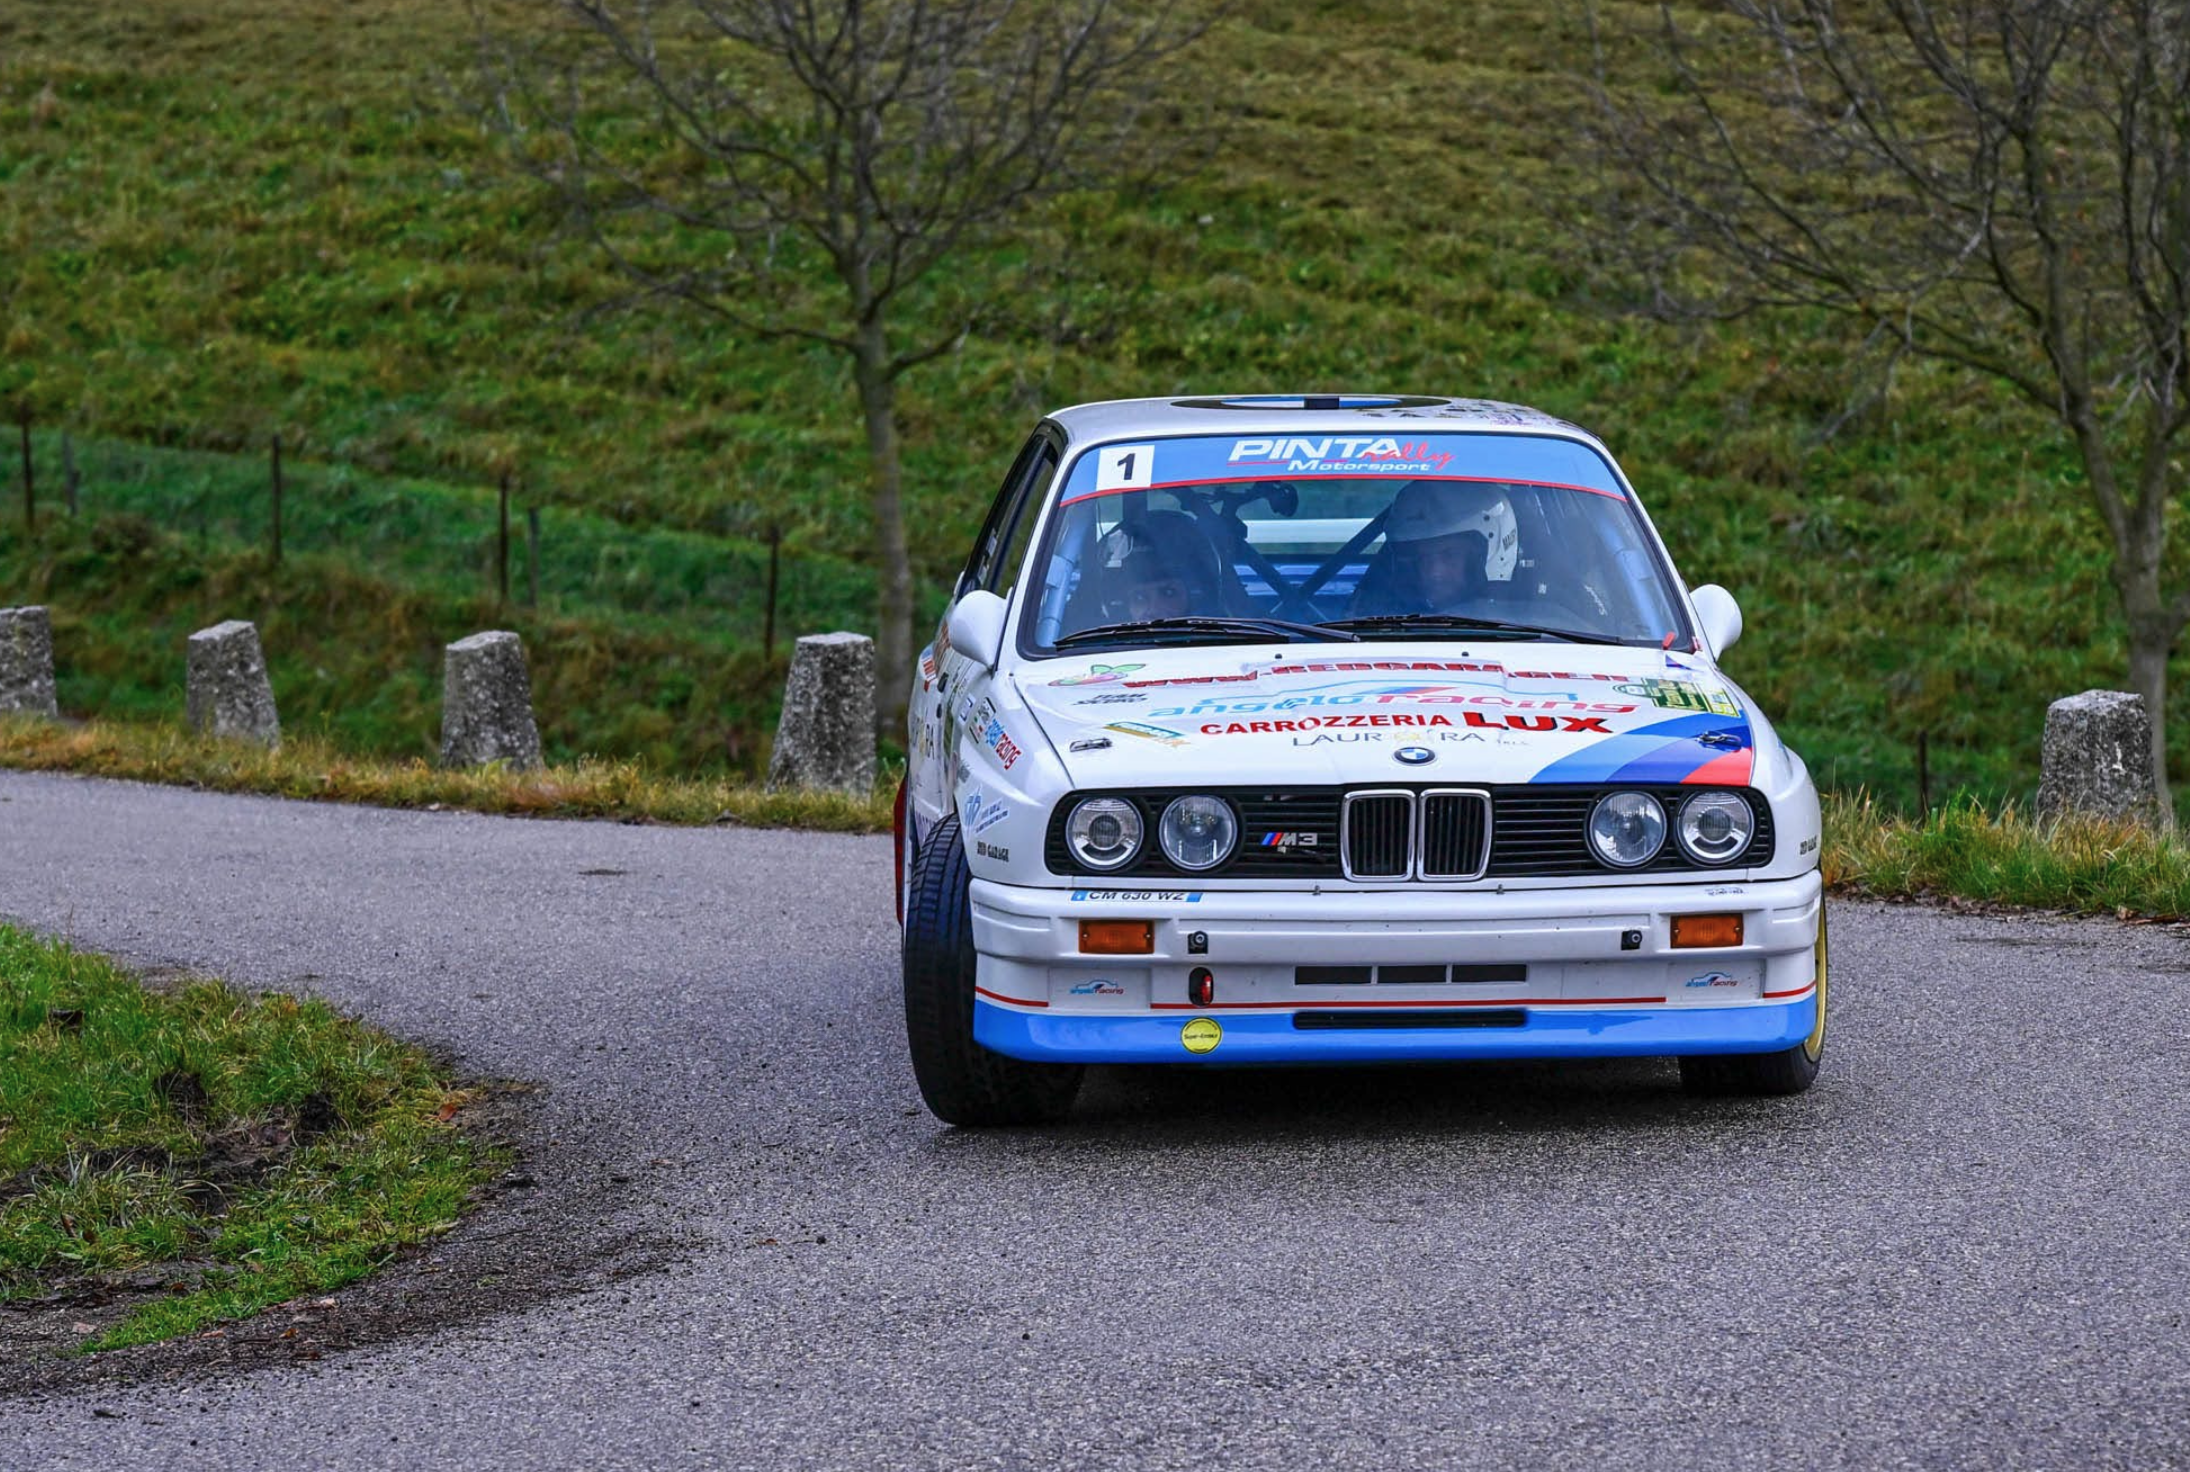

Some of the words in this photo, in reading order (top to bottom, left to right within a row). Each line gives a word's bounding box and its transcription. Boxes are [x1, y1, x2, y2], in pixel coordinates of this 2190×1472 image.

[1228, 438, 1402, 461] PINTA
[1361, 442, 1456, 471] rally
[1116, 452, 1136, 481] 1
[1287, 459, 1431, 472] Motorsport
[1200, 714, 1453, 735] CARROZZERIA
[1462, 711, 1614, 733] LUX
[1277, 832, 1318, 846] M3
[1089, 891, 1117, 900] CM
[1158, 892, 1187, 901] WZ
